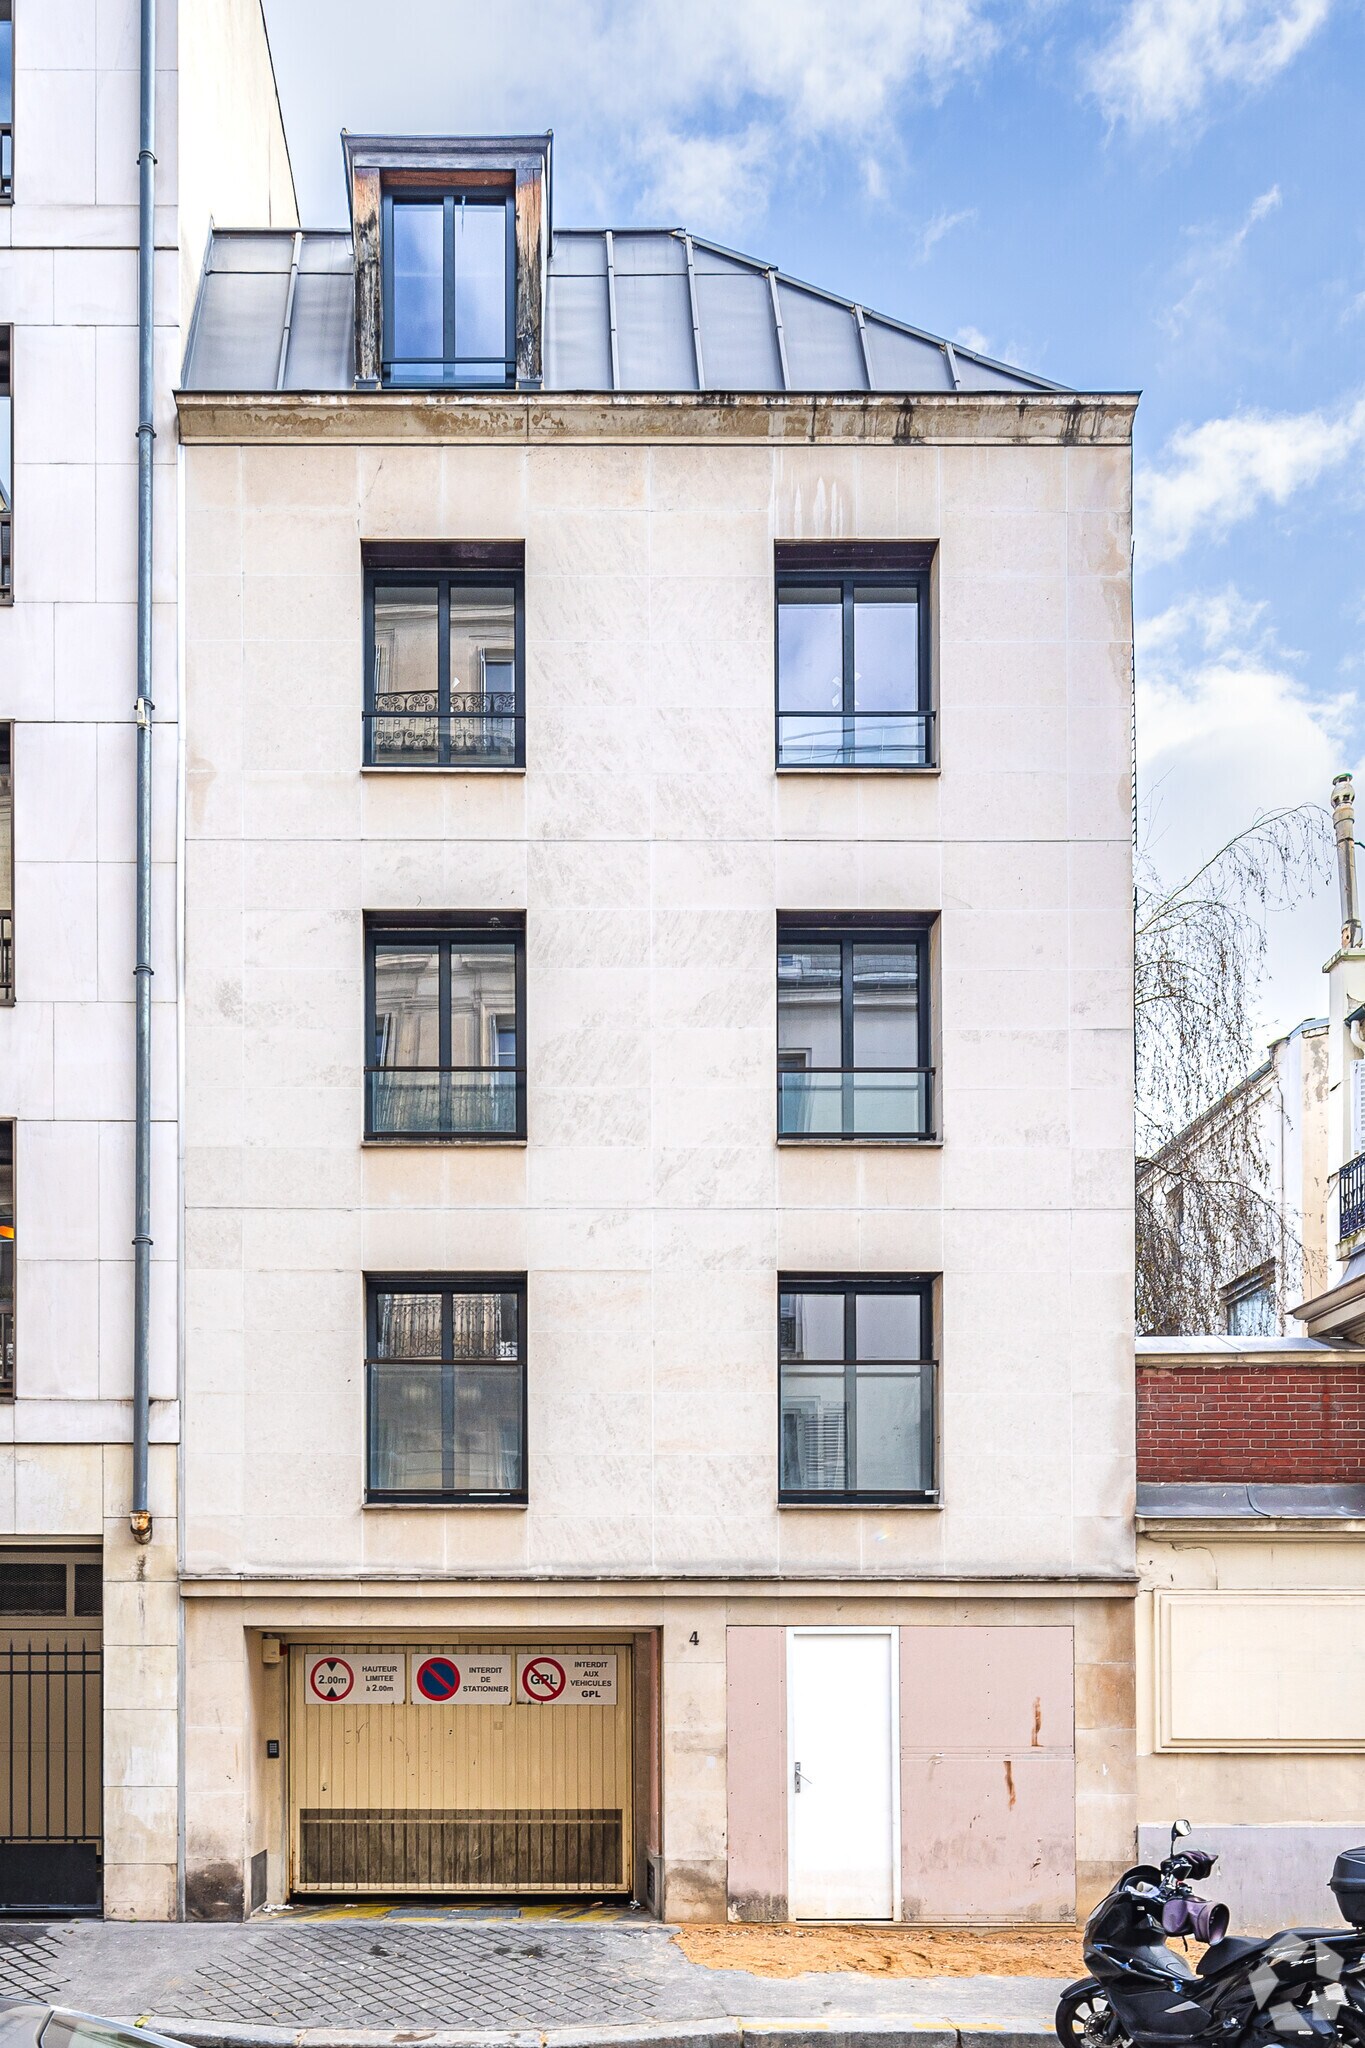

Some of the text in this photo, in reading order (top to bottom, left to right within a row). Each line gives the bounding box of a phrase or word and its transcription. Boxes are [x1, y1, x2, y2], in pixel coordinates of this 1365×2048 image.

[689, 1631, 700, 1646] 4
[318, 1675, 347, 1684] 2.00m
[530, 1674, 557, 1684] GPL
[581, 1690, 601, 1698] GPL
